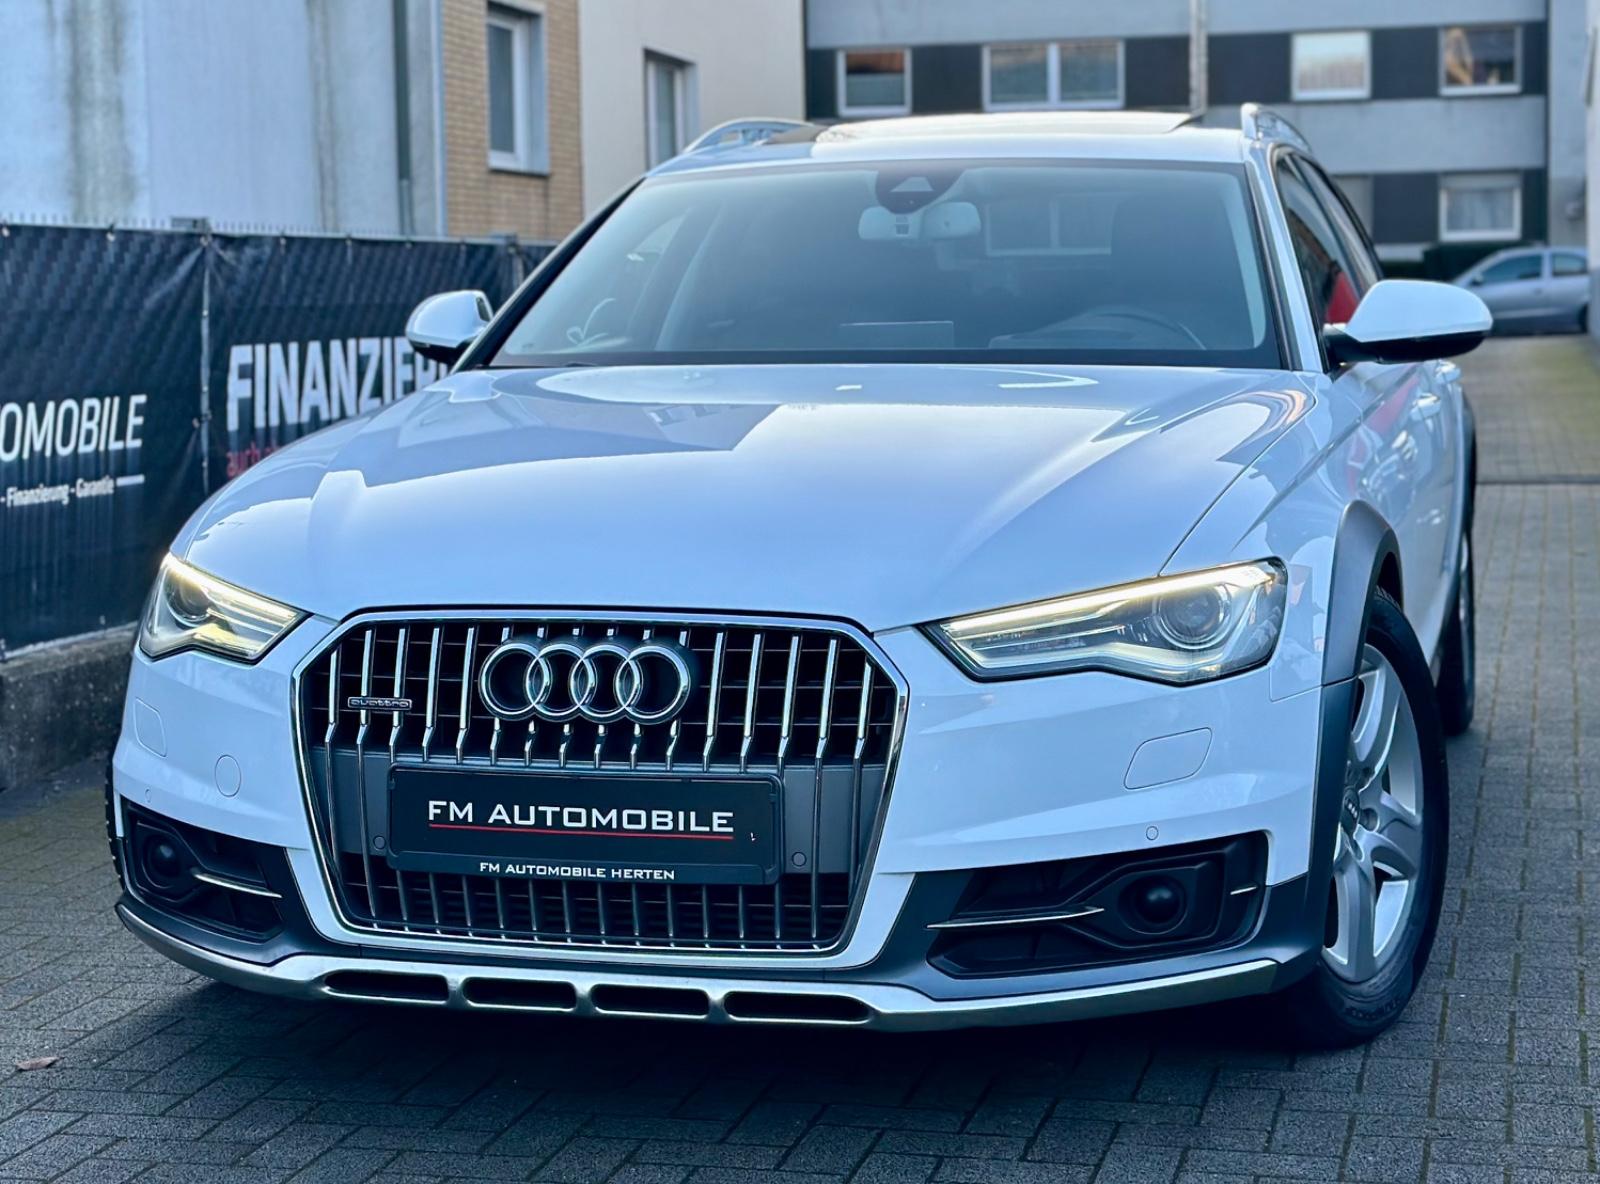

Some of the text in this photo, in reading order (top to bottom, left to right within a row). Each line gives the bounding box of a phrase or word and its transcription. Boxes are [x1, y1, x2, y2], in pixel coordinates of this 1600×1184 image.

[227, 336, 448, 432] FINANZIE
[0, 394, 147, 462] OMOBILE
[350, 699, 409, 708] quattro
[428, 800, 734, 833] FM AUTOMOBILE
[479, 862, 675, 880] FM AUTOMOBILE HERTEN
